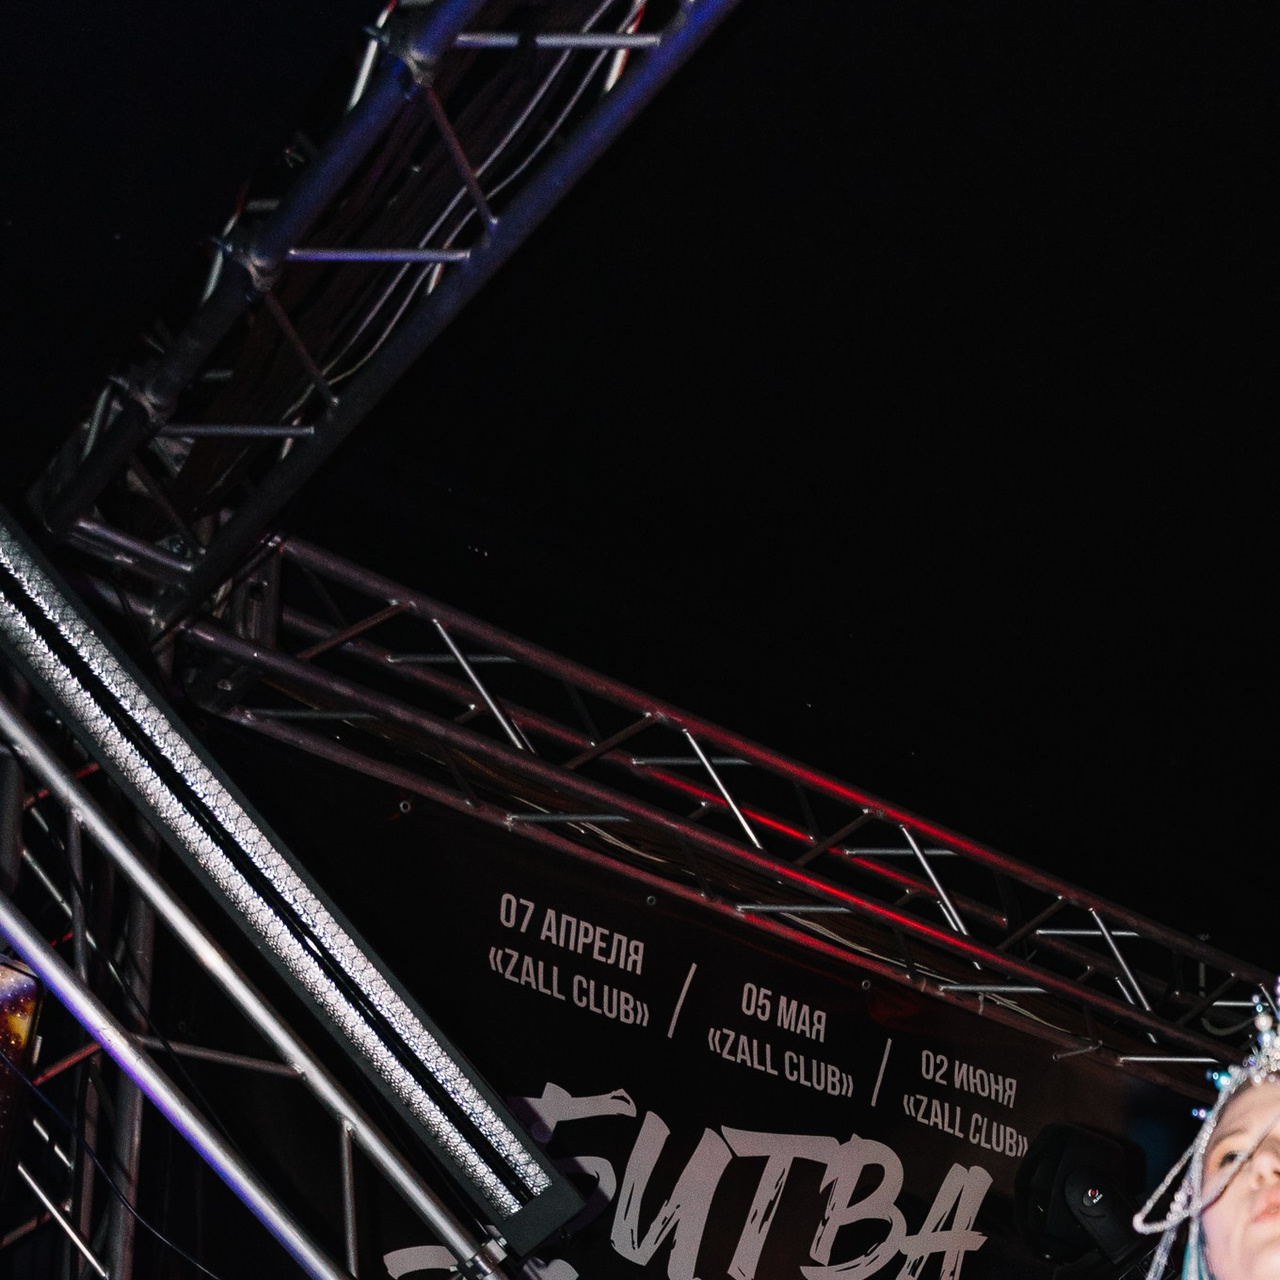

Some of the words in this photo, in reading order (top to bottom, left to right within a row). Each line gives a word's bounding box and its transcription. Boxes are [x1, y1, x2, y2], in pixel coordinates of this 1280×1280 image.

[499, 892, 534, 935] 07
[539, 908, 645, 976] АПРЕЛЯ
[488, 945, 567, 1001] «ZALL
[572, 976, 650, 1029] CLUB»
[741, 982, 772, 1022] 05
[776, 995, 827, 1043] МАЯ
[707, 1027, 779, 1077] «ZALL
[784, 1050, 854, 1099] CLUB»
[920, 1049, 949, 1085] 02
[953, 1061, 1018, 1109] ИЮНЯ
[903, 1094, 964, 1138] «ZALL
